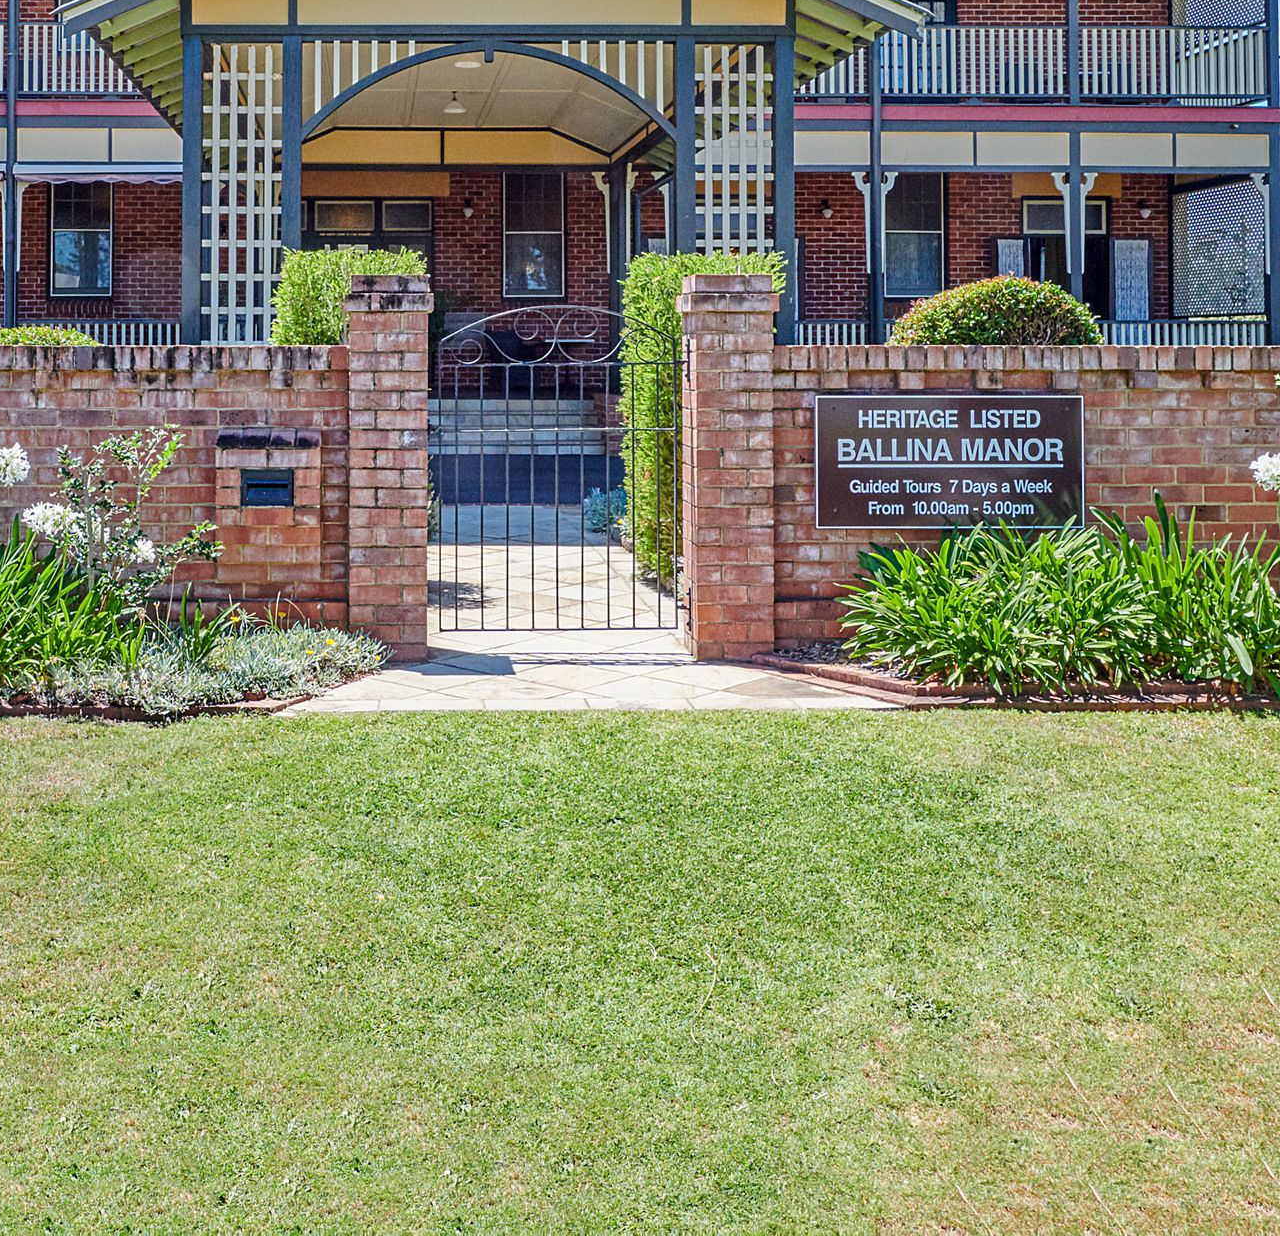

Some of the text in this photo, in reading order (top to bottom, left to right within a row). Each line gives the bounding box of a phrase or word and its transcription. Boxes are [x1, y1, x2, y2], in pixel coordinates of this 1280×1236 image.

[858, 410, 1041, 429] HERITAGE LISTED
[837, 438, 1064, 461] BALLINA MANOR
[849, 480, 1053, 497] Guided Tours 7 Days a Week
[868, 501, 904, 515] From
[912, 501, 969, 515] 10.00am
[982, 501, 1034, 518] 5.00pm
